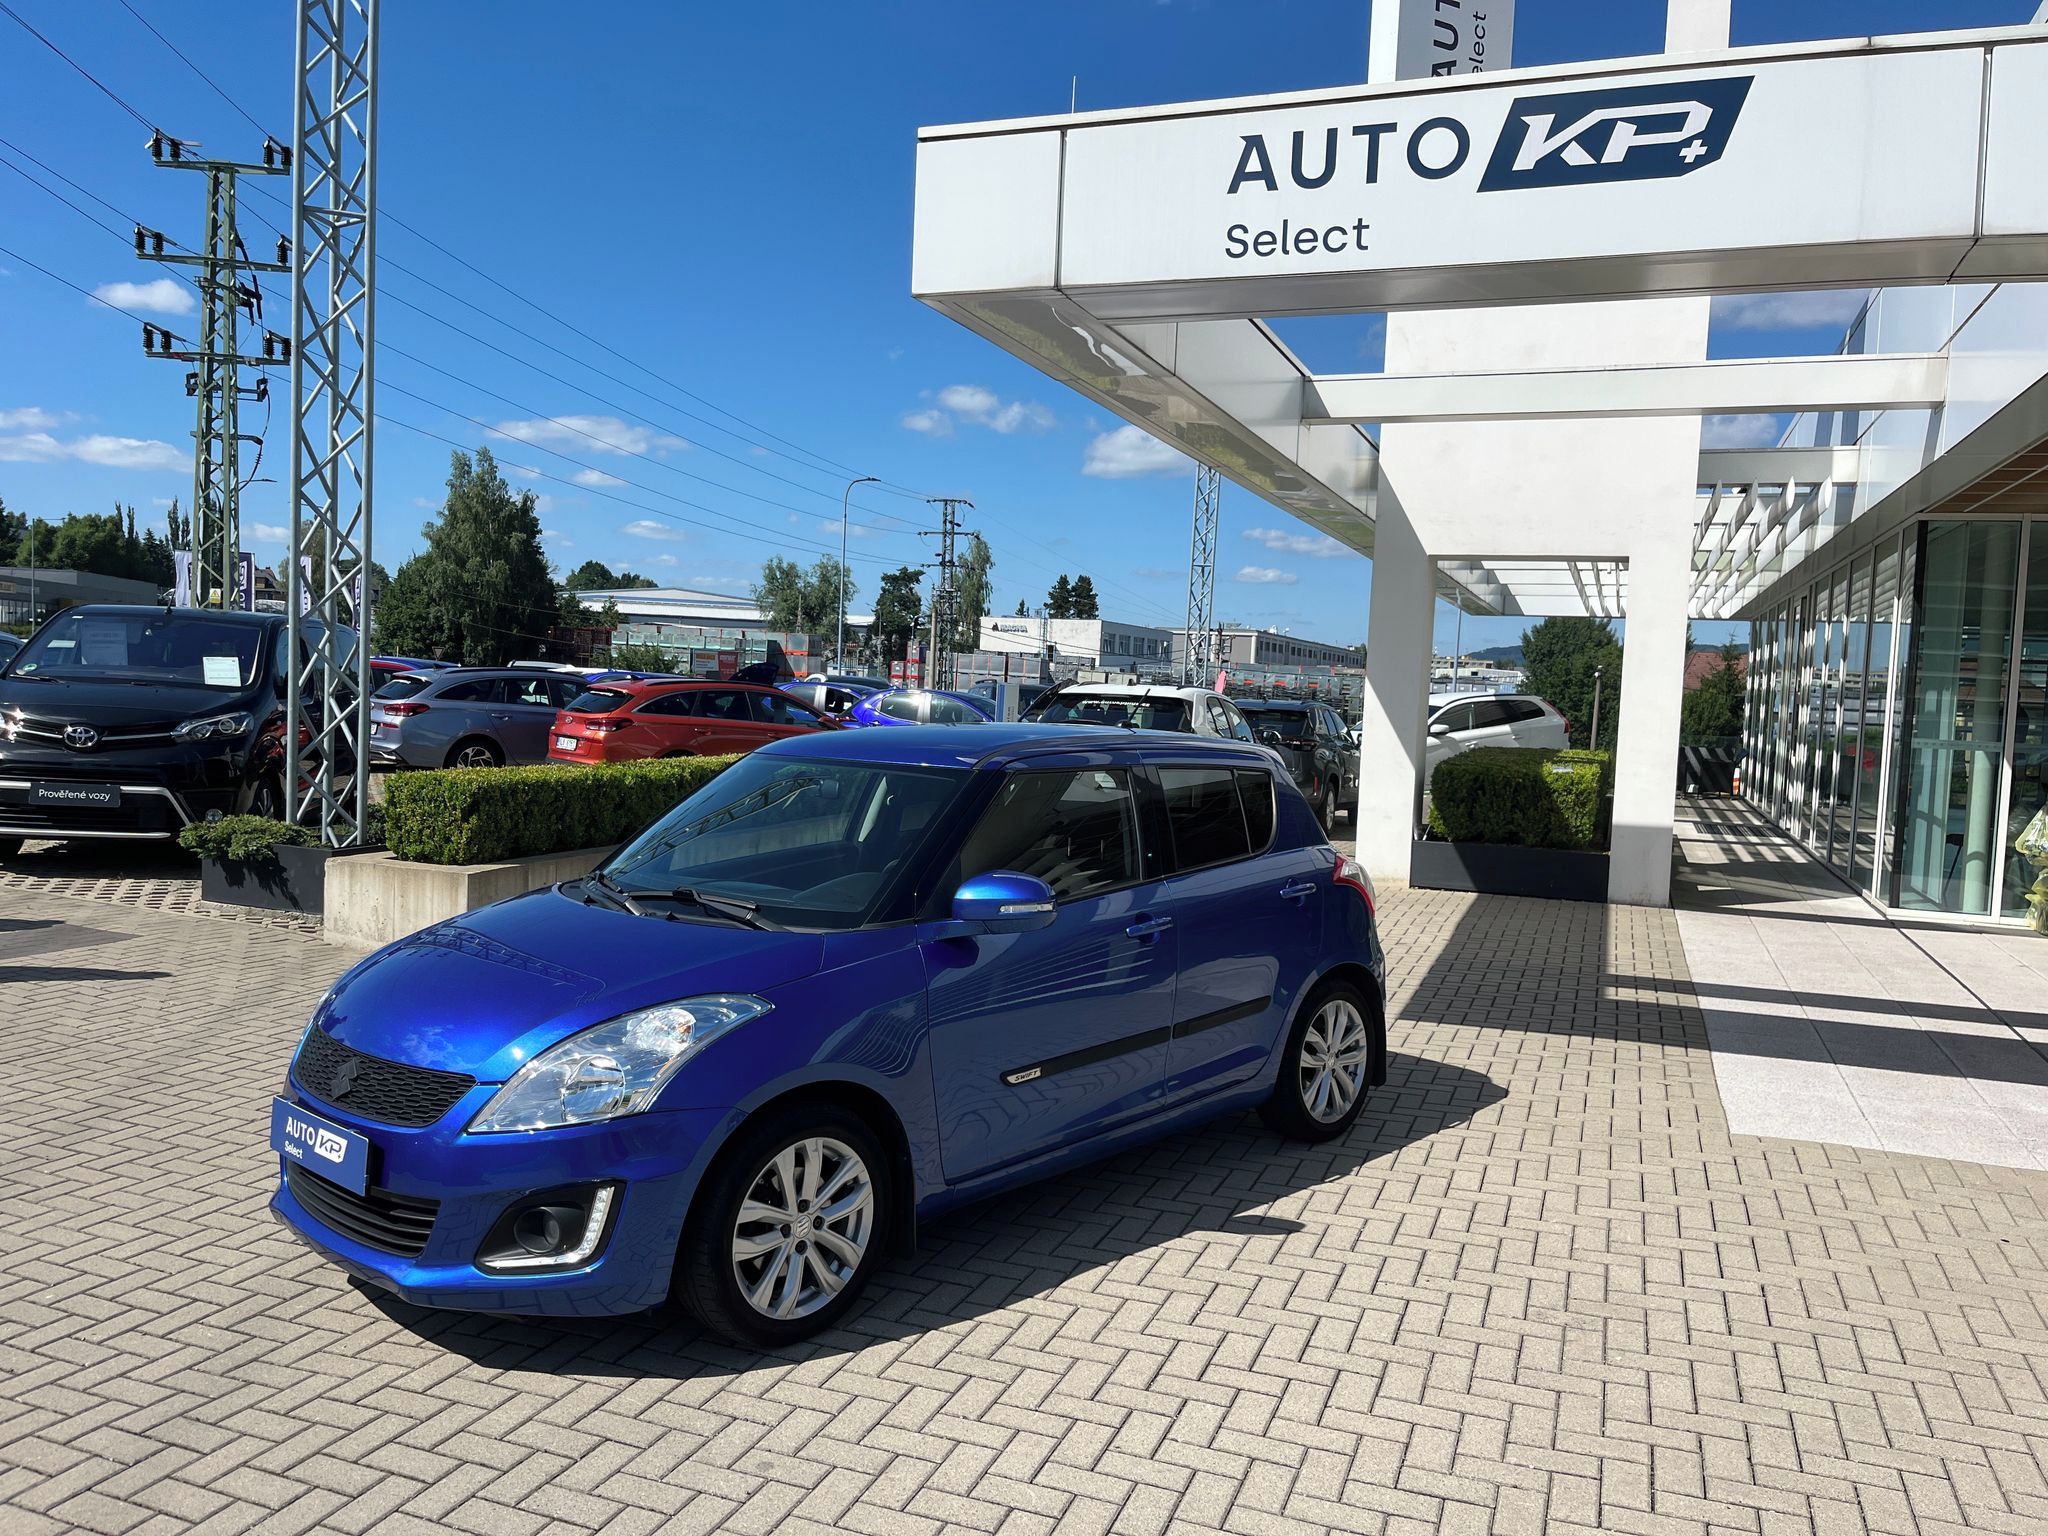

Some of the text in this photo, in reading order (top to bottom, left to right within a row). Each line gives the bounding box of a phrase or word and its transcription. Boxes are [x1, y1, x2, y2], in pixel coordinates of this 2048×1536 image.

[1431, 0, 1461, 77] AUT
[1468, 11, 1487, 73] elect
[1226, 116, 1471, 195] AUTO
[1224, 217, 1370, 259] Select
[38, 788, 111, 802] Prověřené vozy
[1014, 1069, 1039, 1082] SWIFT
[285, 1116, 316, 1146] AUTO
[284, 1140, 304, 1160] Select
